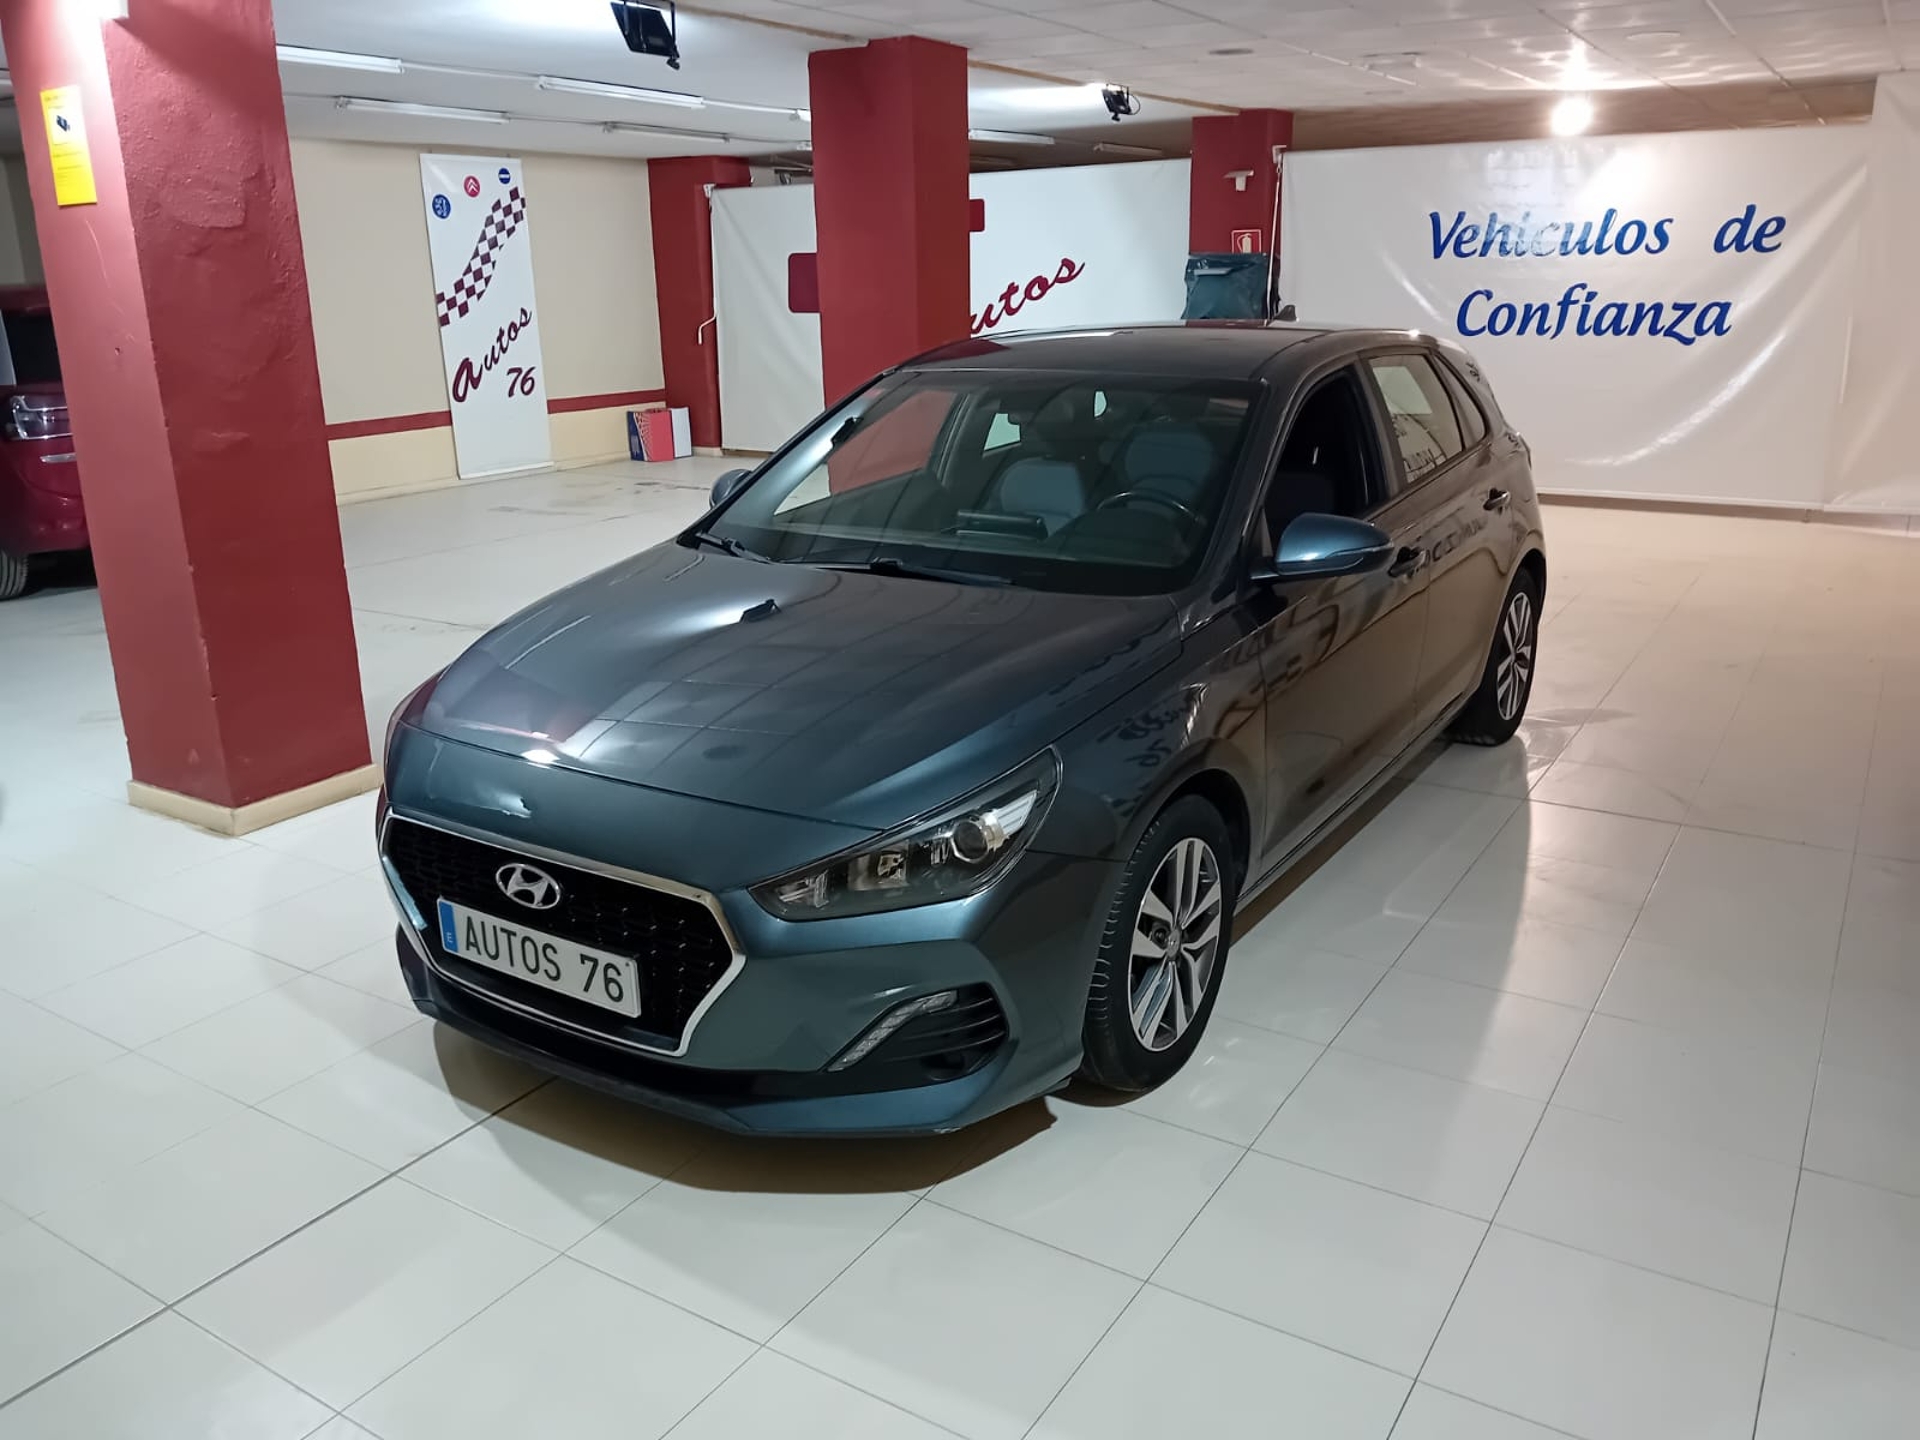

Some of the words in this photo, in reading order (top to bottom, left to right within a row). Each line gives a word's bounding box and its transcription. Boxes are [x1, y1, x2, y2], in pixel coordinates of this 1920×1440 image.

[1713, 204, 1786, 253] de
[969, 257, 1086, 335] utos
[1456, 282, 1732, 346] Confianza
[506, 366, 536, 398] 76
[466, 916, 561, 982] AUTOS
[579, 953, 624, 1003] 76
